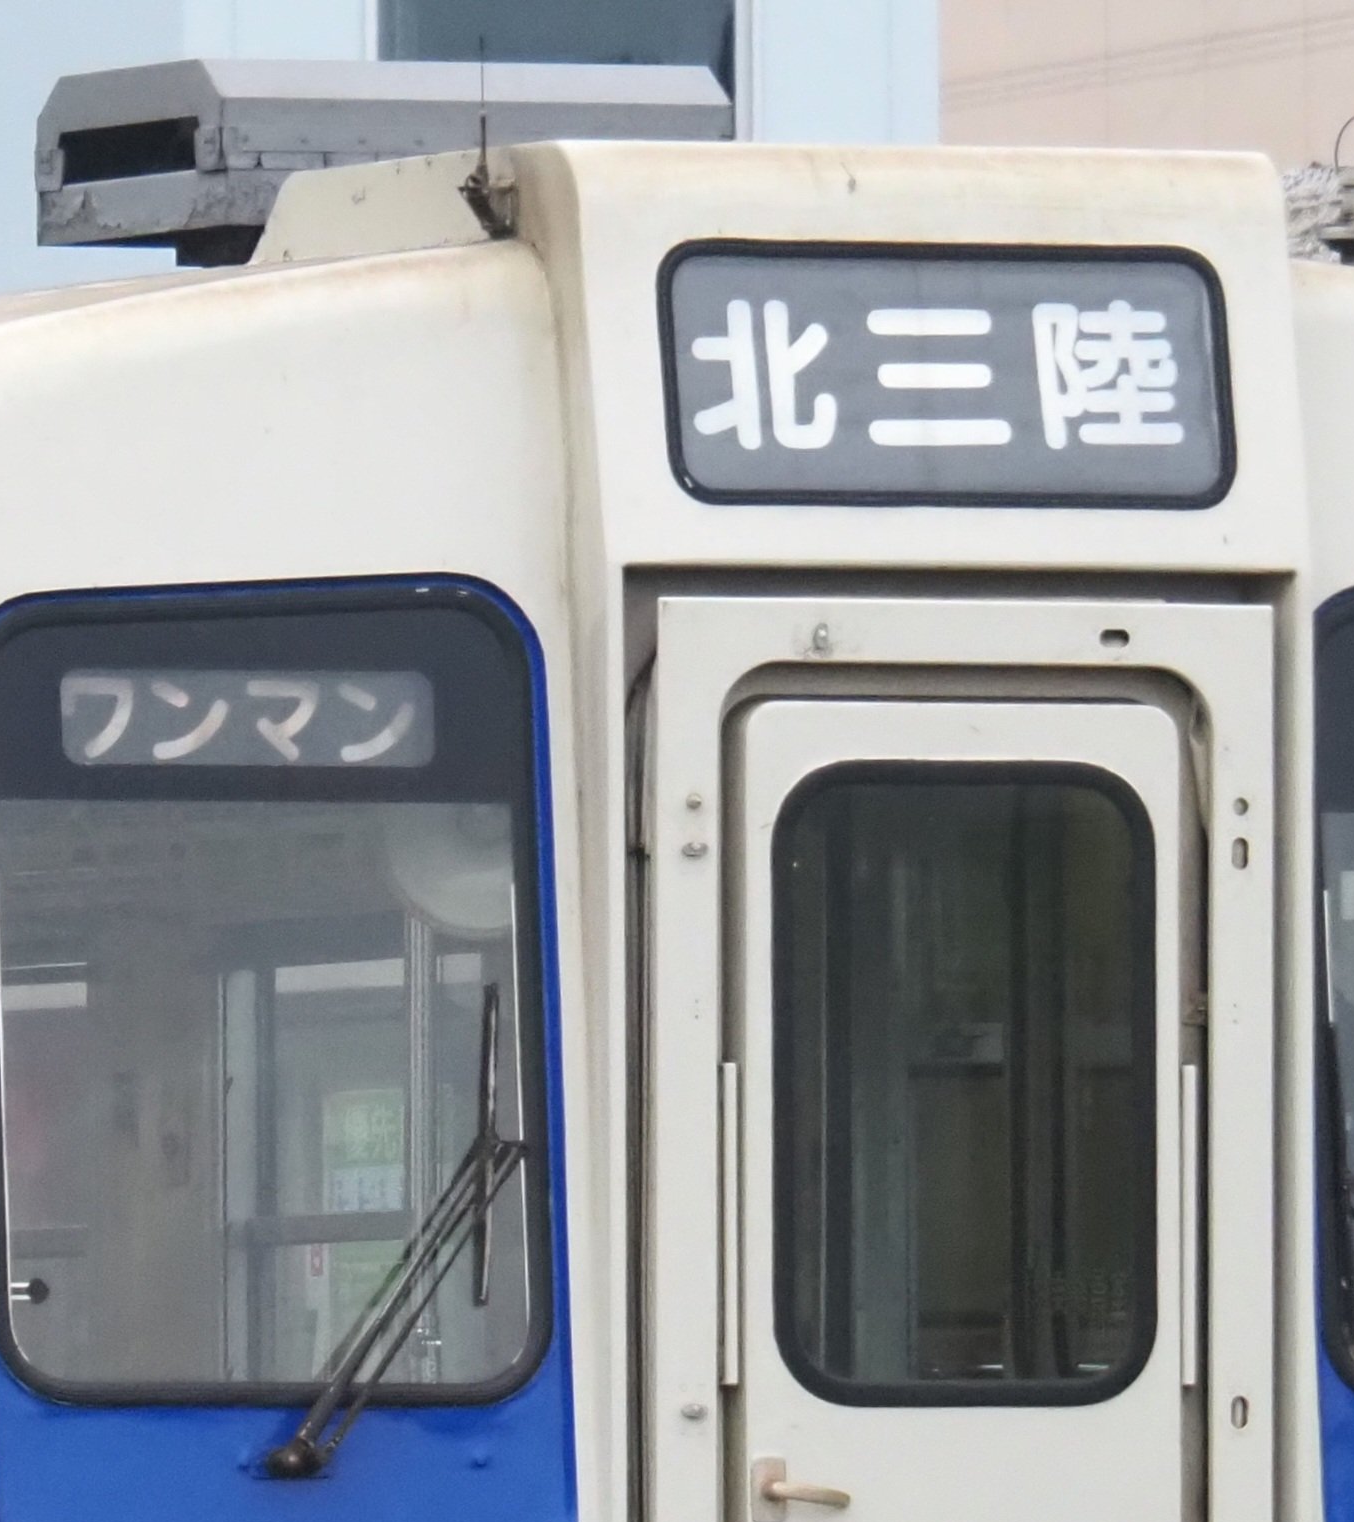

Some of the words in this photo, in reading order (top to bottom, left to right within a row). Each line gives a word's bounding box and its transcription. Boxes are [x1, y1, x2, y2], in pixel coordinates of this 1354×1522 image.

[691, 299, 1185, 450] 北三陸
[60, 677, 416, 763] ワンマン
